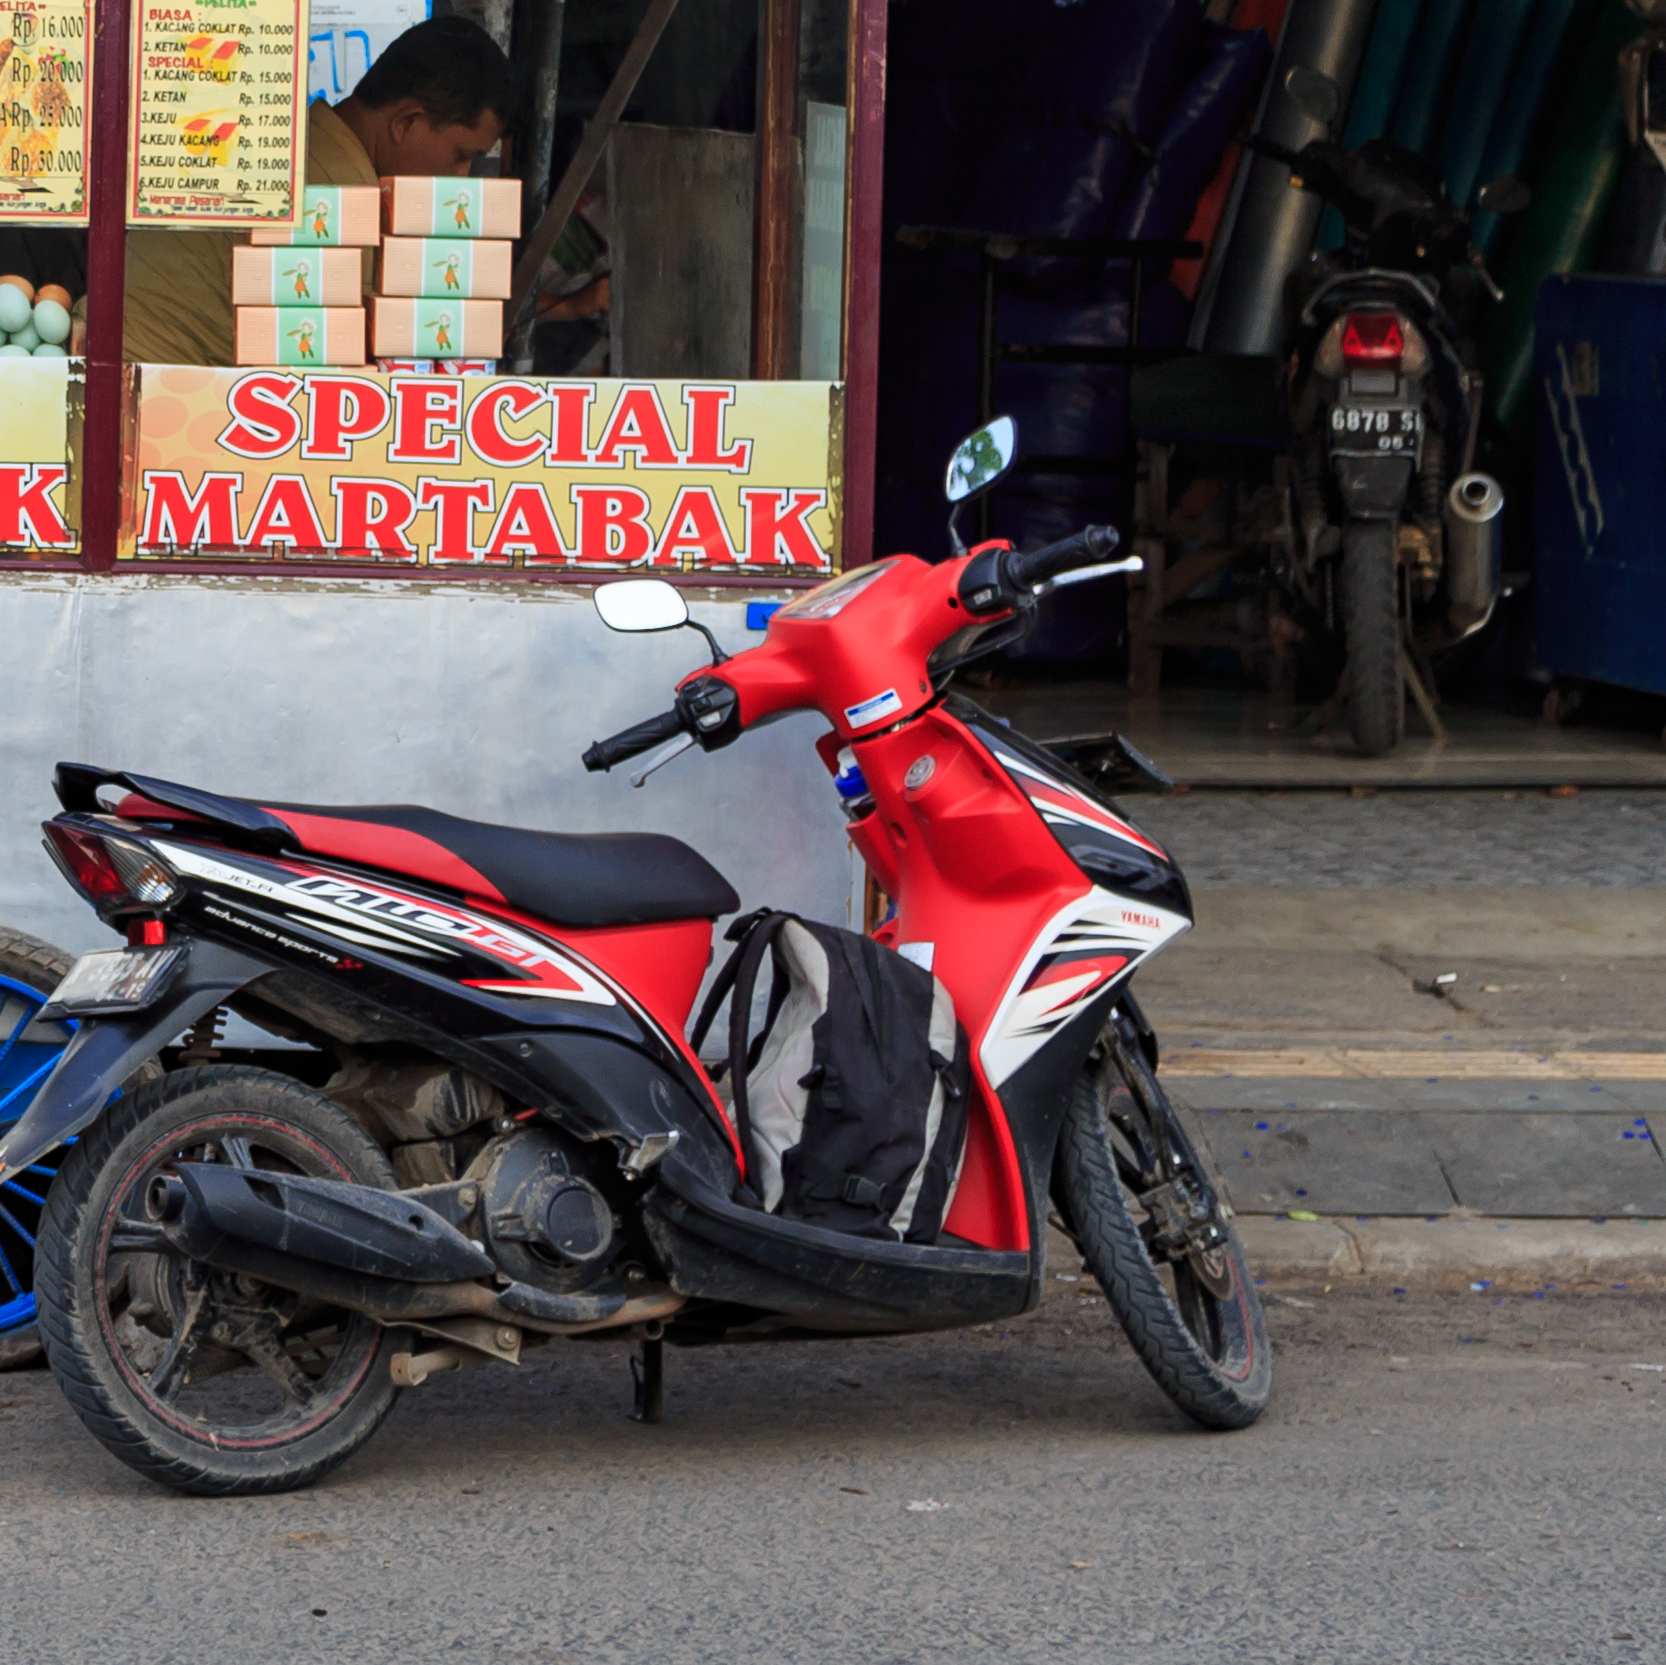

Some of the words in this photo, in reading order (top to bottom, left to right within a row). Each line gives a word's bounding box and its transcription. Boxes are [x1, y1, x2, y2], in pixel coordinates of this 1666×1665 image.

[149, 9, 192, 22] BIASA
[13, 12, 35, 43] Rp.
[42, 15, 84, 38] 16.000
[155, 22, 195, 34] KACANG
[198, 23, 237, 34] COKLAT
[238, 24, 254, 36] Rp.
[259, 25, 294, 36] 10.000
[143, 41, 152, 52] 2.
[154, 42, 187, 53] KETAN
[238, 44, 254, 56] Rp.
[259, 44, 293, 55] 10.000
[148, 56, 204, 69] SPECIAL
[12, 56, 35, 88] Rp.
[40, 60, 84, 83] 20.000
[154, 70, 195, 81] KACANG
[198, 71, 238, 82] COKLAT
[239, 71, 255, 84] Rp.
[259, 72, 292, 83] 15.000
[142, 91, 150, 102] 2.
[153, 91, 187, 103] KETAN
[239, 93, 254, 106] Rp.
[259, 94, 291, 105] 15.000
[11, 101, 34, 133] Rp.
[40, 105, 83, 127] 25.000
[238, 114, 254, 127] Rp.
[258, 115, 291, 126] 17.000
[178, 134, 220, 146] KACANG
[238, 136, 253, 150] Rp.
[258, 137, 290, 148] 19.000
[10, 146, 33, 177] Rp.
[178, 156, 218, 168] COKLAT
[237, 158, 253, 172] Rp.
[257, 158, 290, 170] 19.000
[177, 178, 219, 190] CAMPUR
[237, 179, 252, 194] Rp.
[256, 180, 289, 191] 21.000
[216, 371, 753, 474] SPECIAL
[137, 470, 833, 573] MARTABAK
[1121, 910, 1161, 929] YAMAHA
[204, 905, 277, 939] advance
[277, 935, 339, 964] sports
